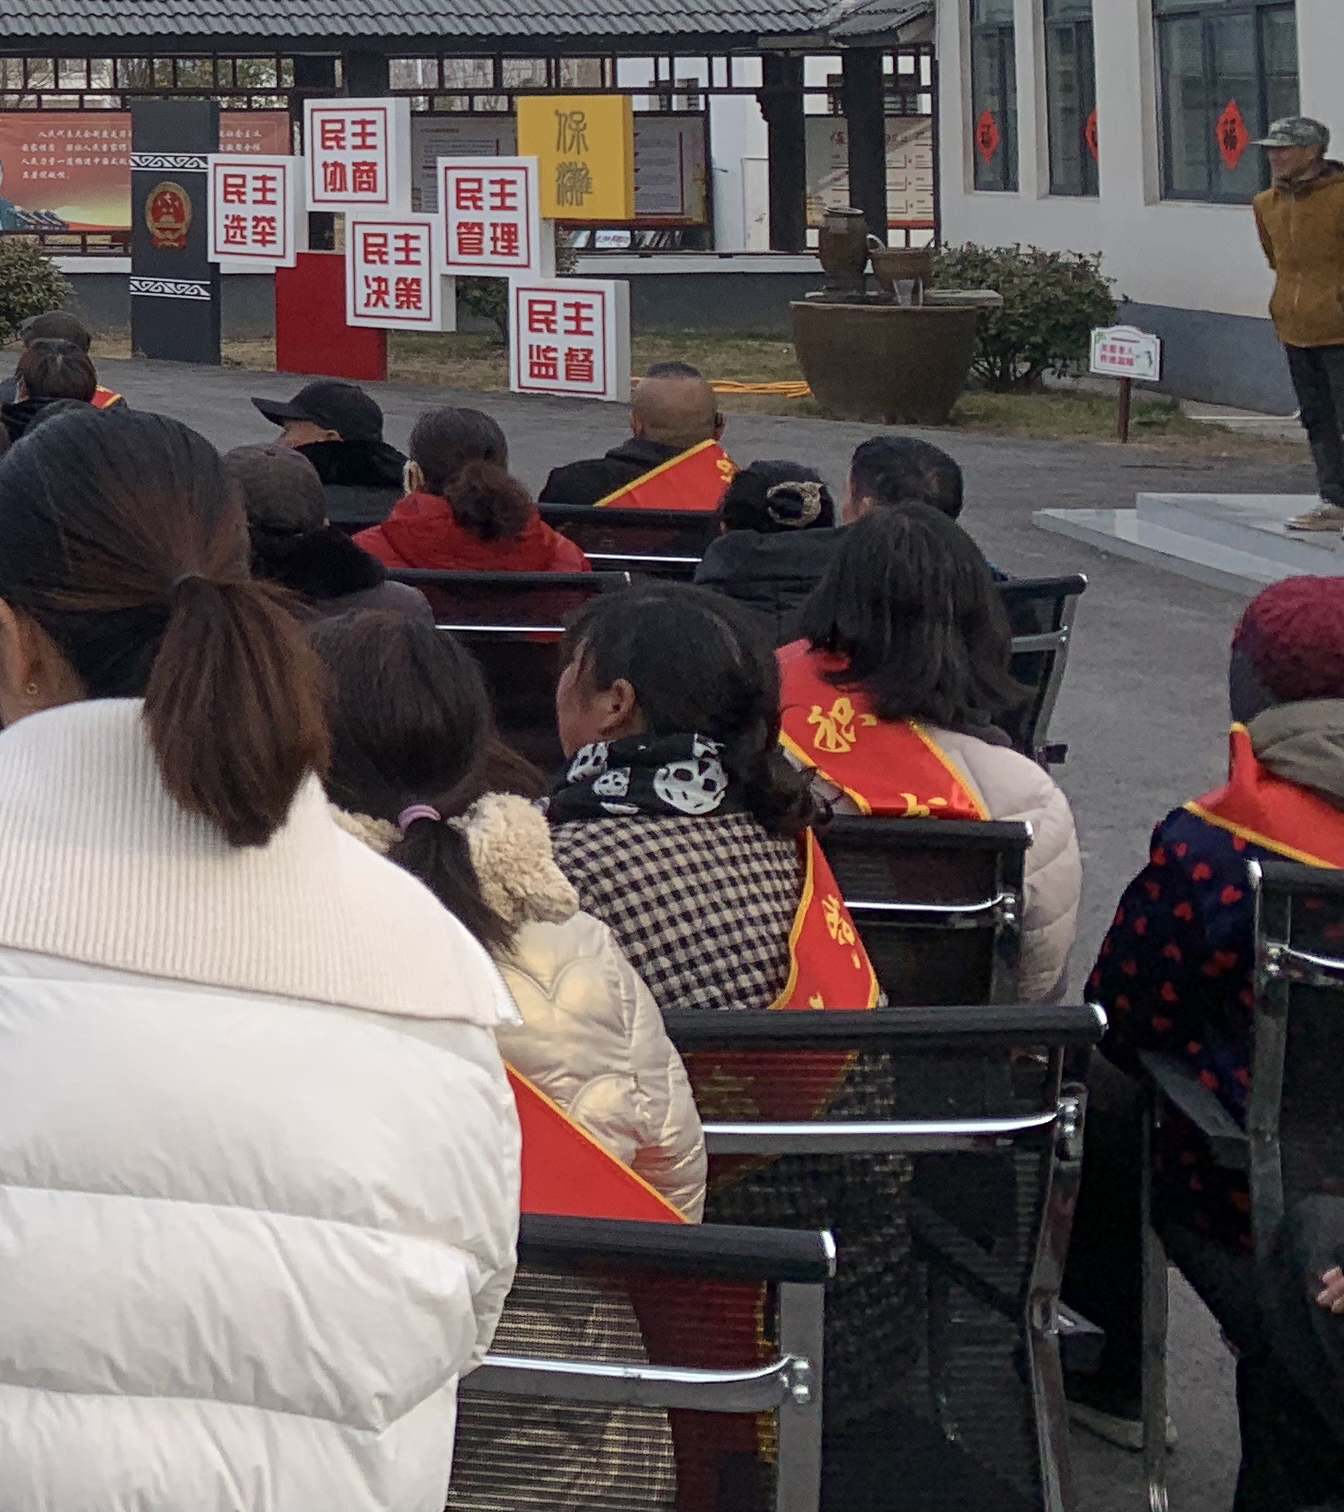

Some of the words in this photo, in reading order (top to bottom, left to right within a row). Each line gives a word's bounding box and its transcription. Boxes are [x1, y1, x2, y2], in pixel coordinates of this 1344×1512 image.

[320, 118, 379, 151] 民主
[222, 173, 278, 206] 民主
[321, 159, 379, 195] 协商
[455, 177, 518, 212] 民主
[222, 213, 278, 247] 选举
[456, 221, 519, 258] 管理
[363, 232, 422, 266] 民主
[363, 274, 423, 311] 决策
[527, 298, 594, 337] 民主
[528, 343, 595, 384] 监督
